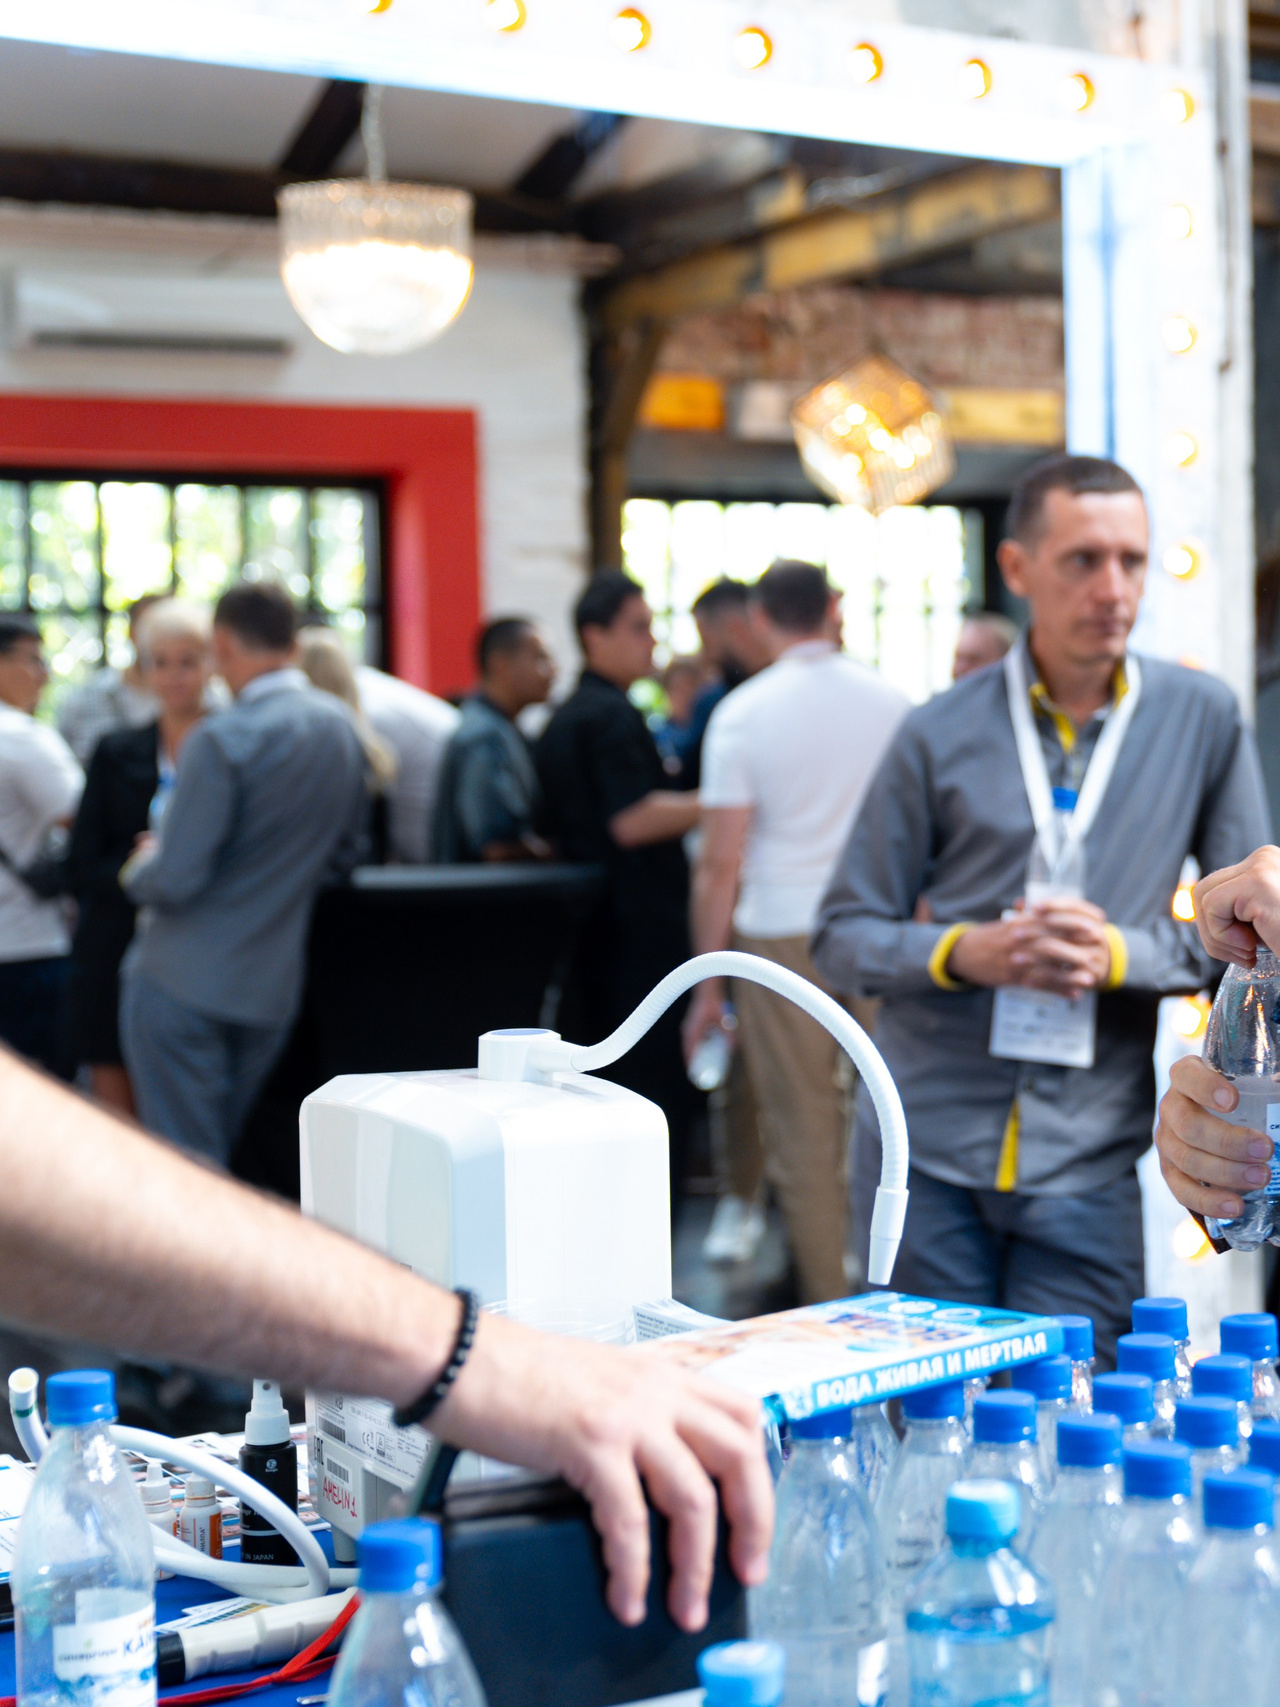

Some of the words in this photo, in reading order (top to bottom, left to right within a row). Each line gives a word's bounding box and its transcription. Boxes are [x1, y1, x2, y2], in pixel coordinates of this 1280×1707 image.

[816, 1374, 873, 1409] ВОДА
[875, 1355, 945, 1393] ЖИВАЯ
[946, 1351, 963, 1376] И
[964, 1331, 1048, 1372] МЕРТВАЯ
